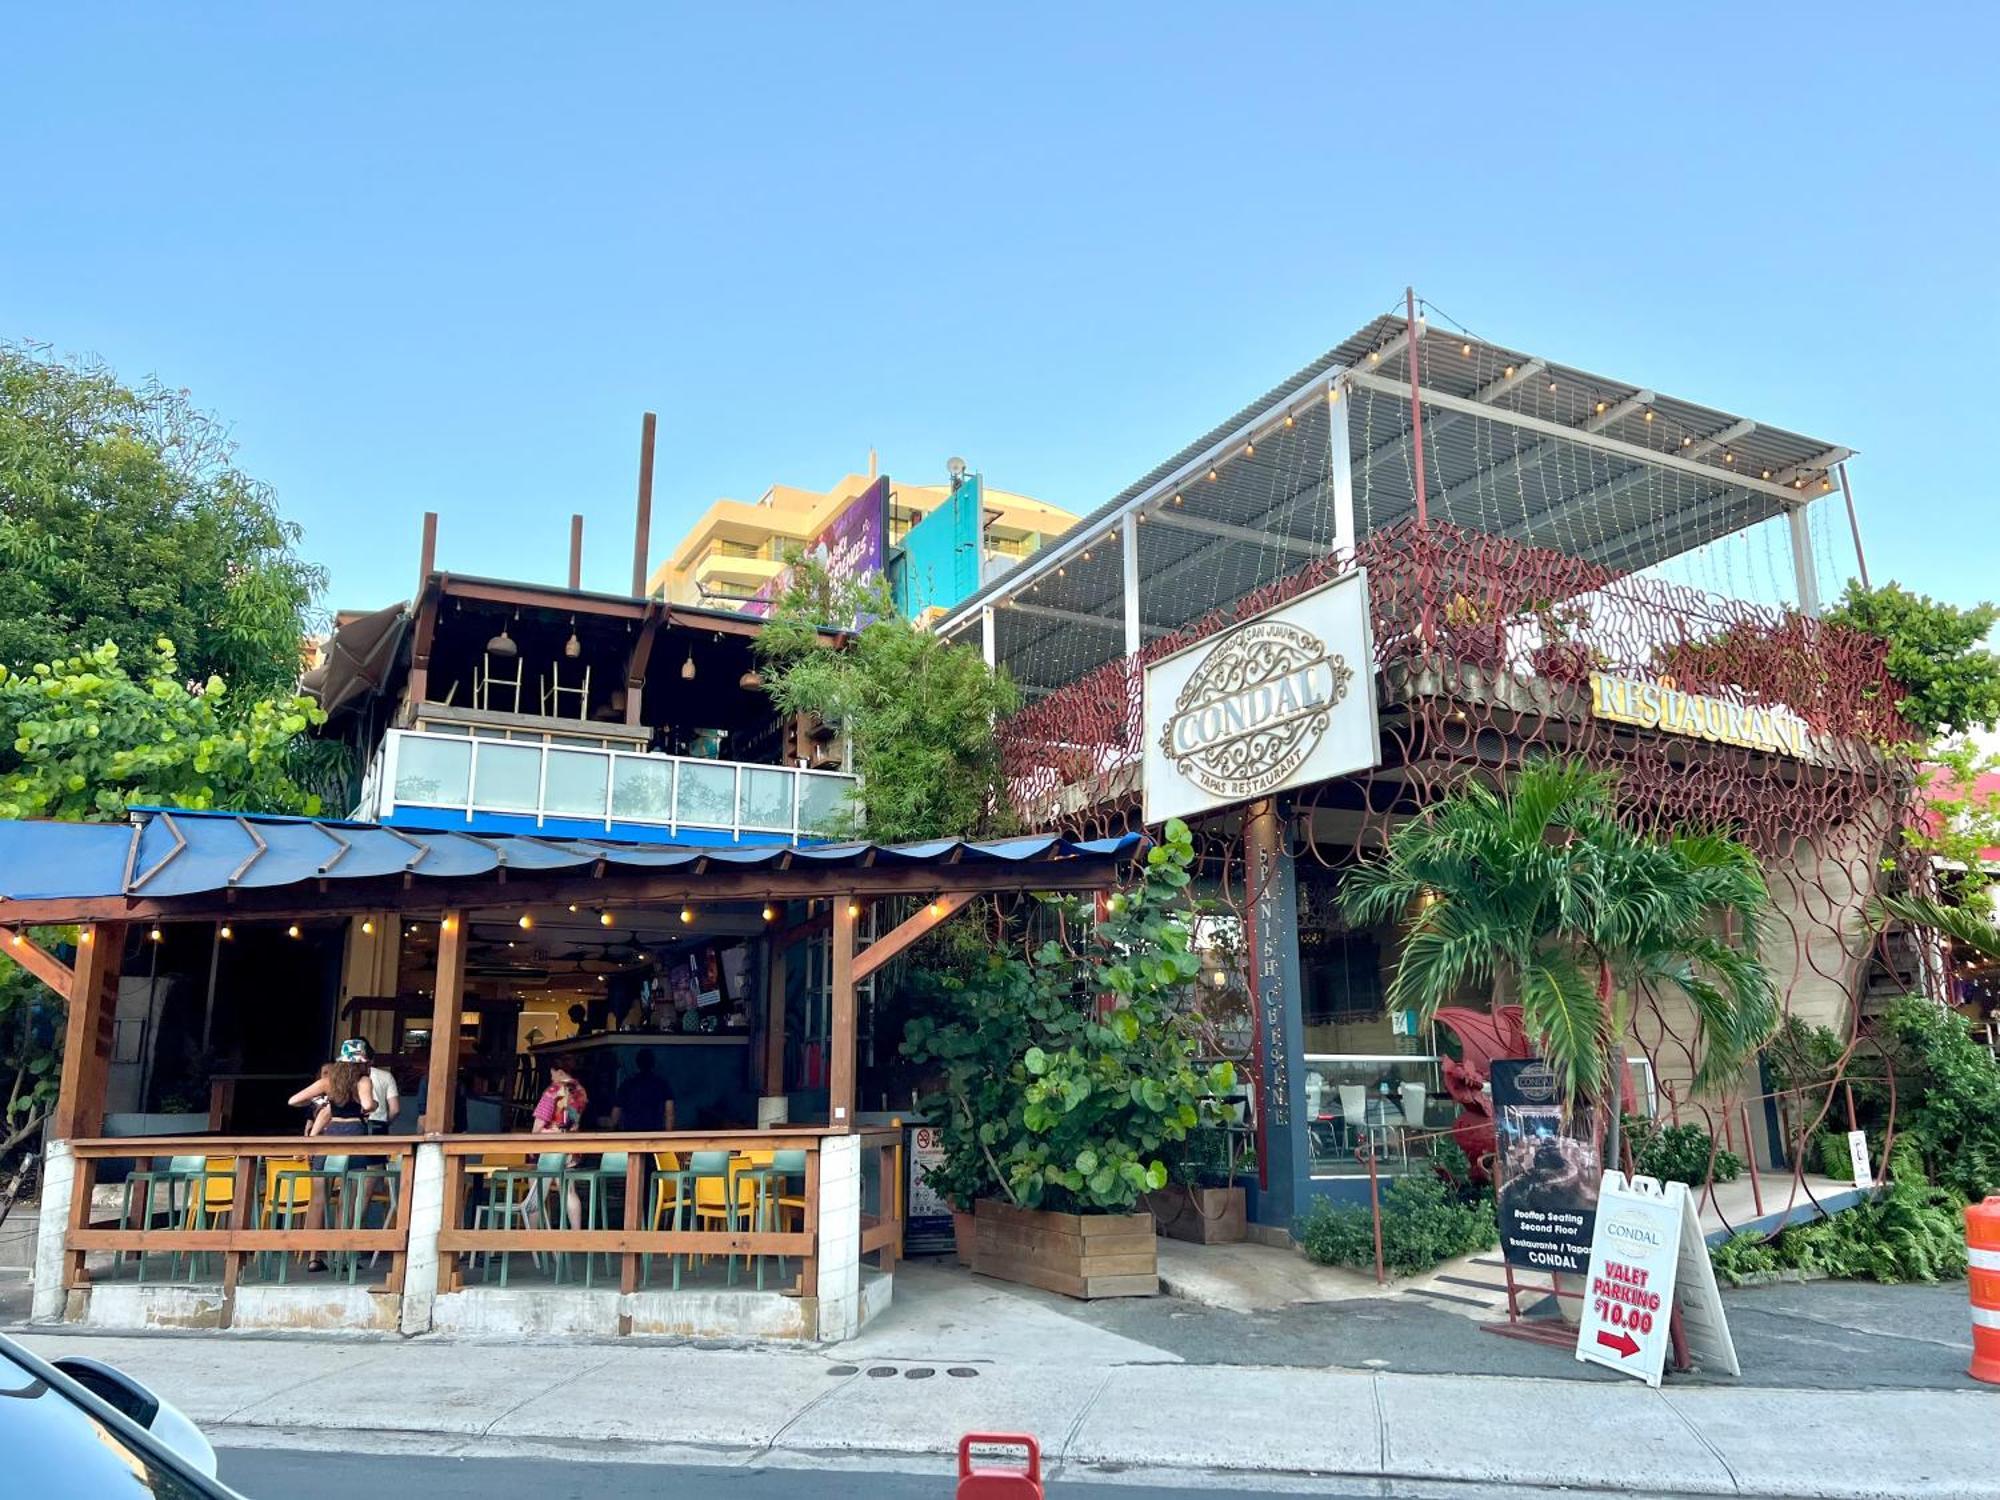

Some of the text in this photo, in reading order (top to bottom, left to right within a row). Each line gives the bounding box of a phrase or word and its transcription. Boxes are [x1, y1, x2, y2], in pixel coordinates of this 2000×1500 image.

[1246, 629, 1265, 641] SAN
[1266, 626, 1293, 638] JUAN
[1178, 668, 1324, 750] CONDAL
[1599, 674, 1809, 753] RESTAURANT
[1200, 748, 1302, 795] TAPAS RESTAURANT
[1260, 848, 1276, 977] SPANISH
[1514, 1209, 1583, 1225] Rooftop Seating
[1520, 1221, 1578, 1235] Second Floor
[1509, 1237, 1558, 1251] Restaurante
[1607, 1223, 1660, 1246] CONDAL
[1528, 1251, 1578, 1269] CONDAL
[1604, 1260, 1649, 1287] VALET
[1592, 1276, 1660, 1312] PARKING
[1594, 1299, 1653, 1335] $10.00
